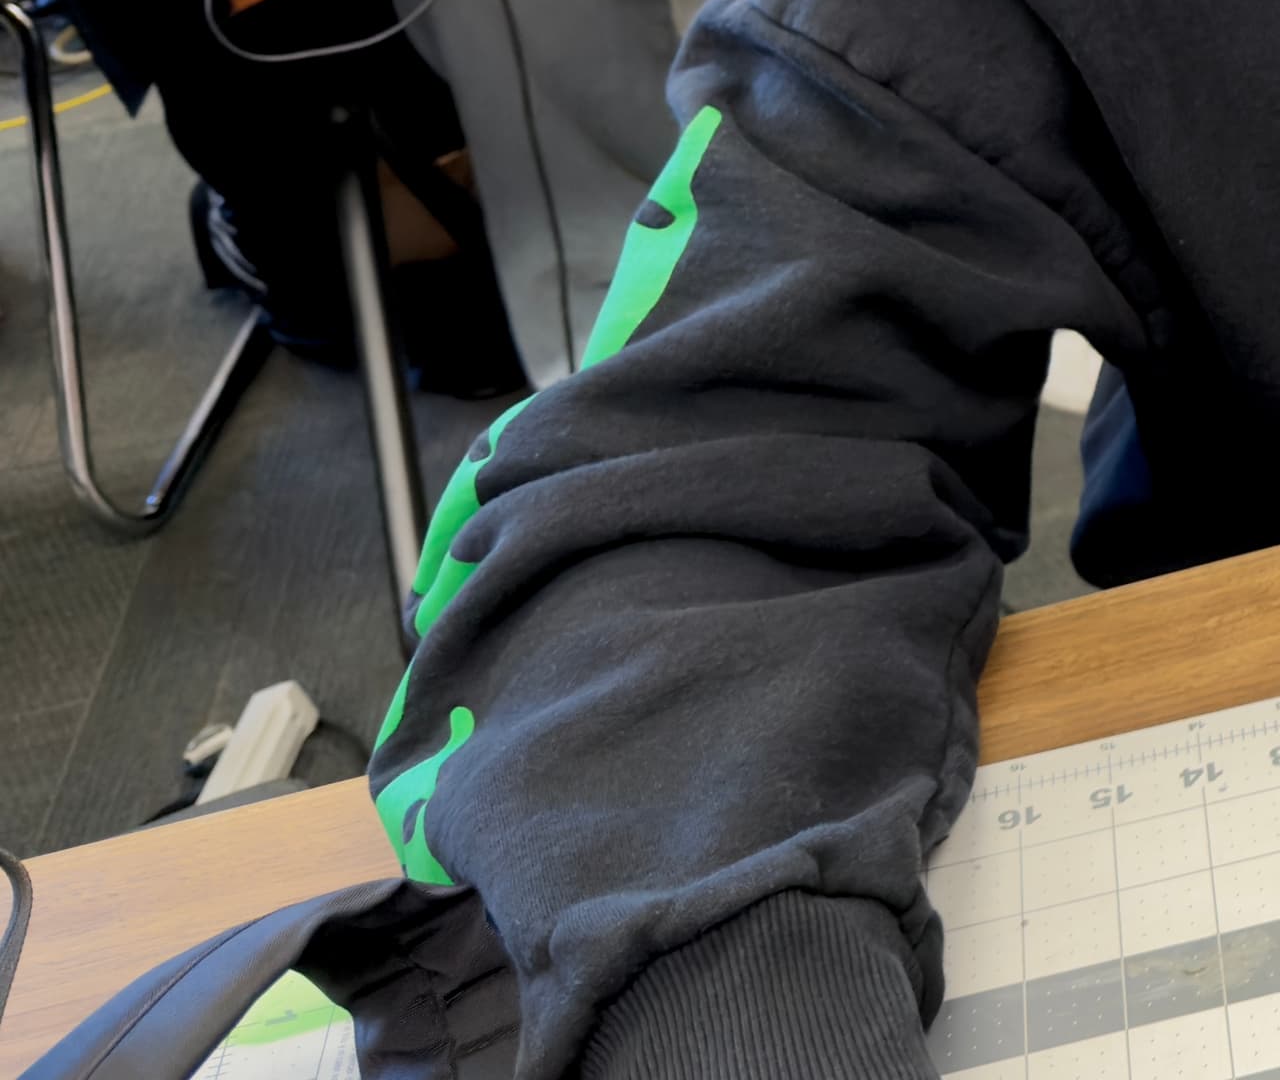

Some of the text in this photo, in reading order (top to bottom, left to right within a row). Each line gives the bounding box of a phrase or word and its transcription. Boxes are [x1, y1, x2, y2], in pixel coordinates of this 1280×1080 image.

[1179, 761, 1224, 788] 14
[1089, 784, 1133, 810] 15
[997, 805, 1042, 830] 16
